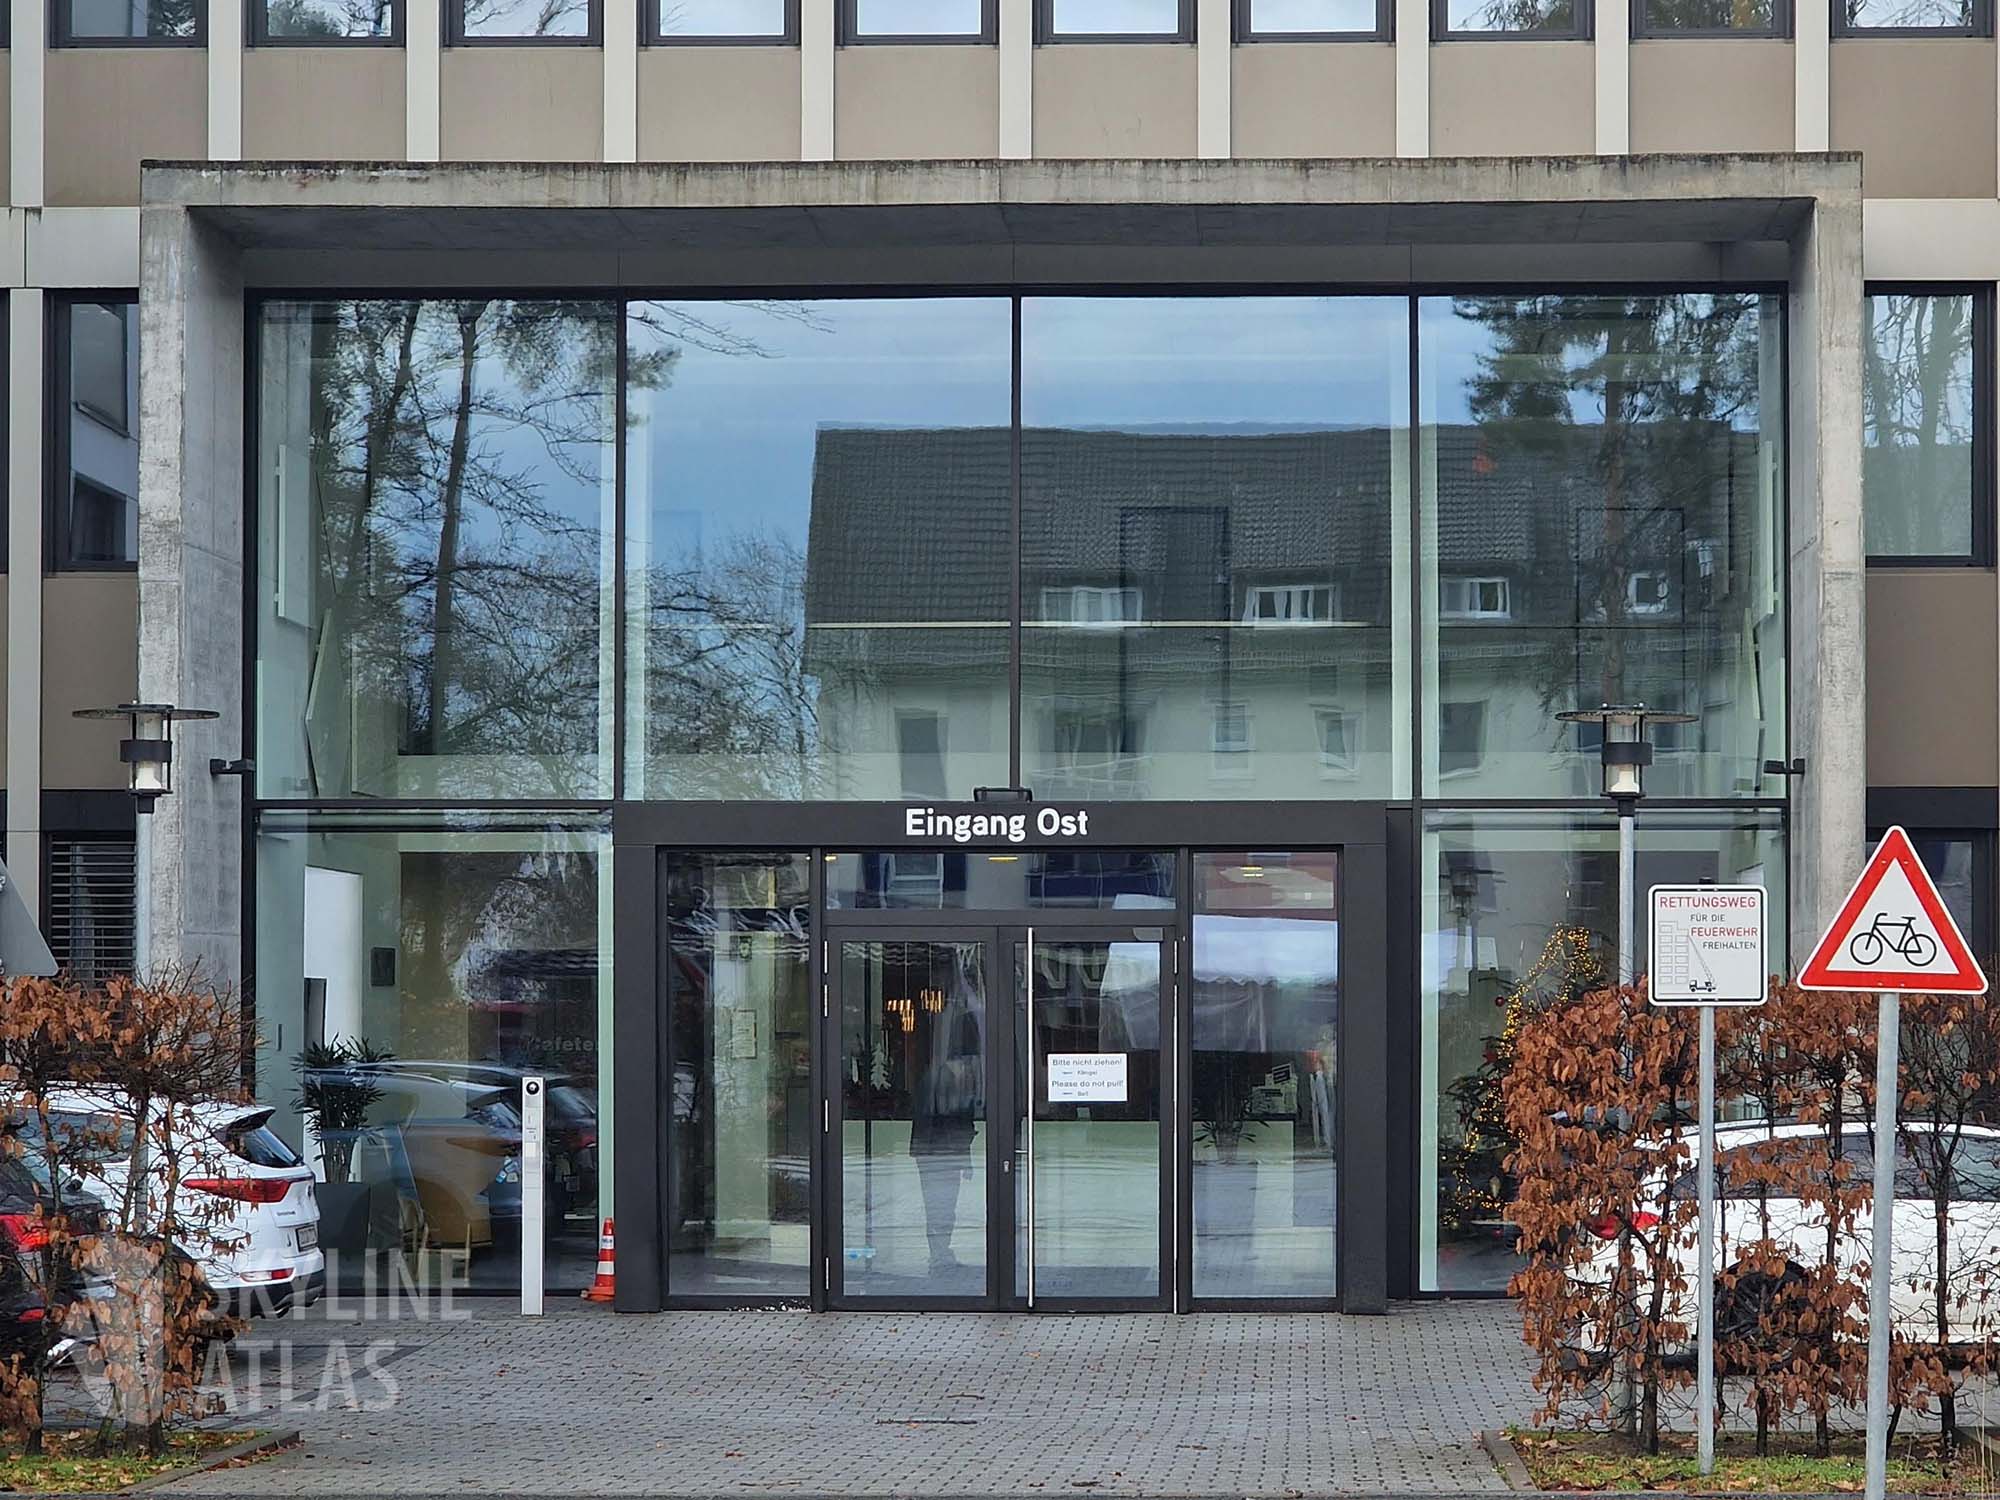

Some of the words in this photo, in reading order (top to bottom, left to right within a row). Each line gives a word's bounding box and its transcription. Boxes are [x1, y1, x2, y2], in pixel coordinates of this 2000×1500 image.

[906, 808, 1026, 842] Eingang
[1037, 808, 1089, 836] Ost
[1660, 896, 1756, 908] RETTUNGSWEG
[1690, 913, 1708, 922] FÜR
[1711, 914, 1726, 922] DIE
[1691, 927, 1758, 937] FEUERWEHR
[1703, 941, 1756, 950] FREIHALTEN
[1052, 1058, 1070, 1066] Bitte
[1072, 1058, 1092, 1066] nicht
[1094, 1058, 1122, 1066] ziehen!
[1051, 1080, 1078, 1088] Please
[1079, 1080, 1091, 1088] do
[1092, 1080, 1105, 1088] not
